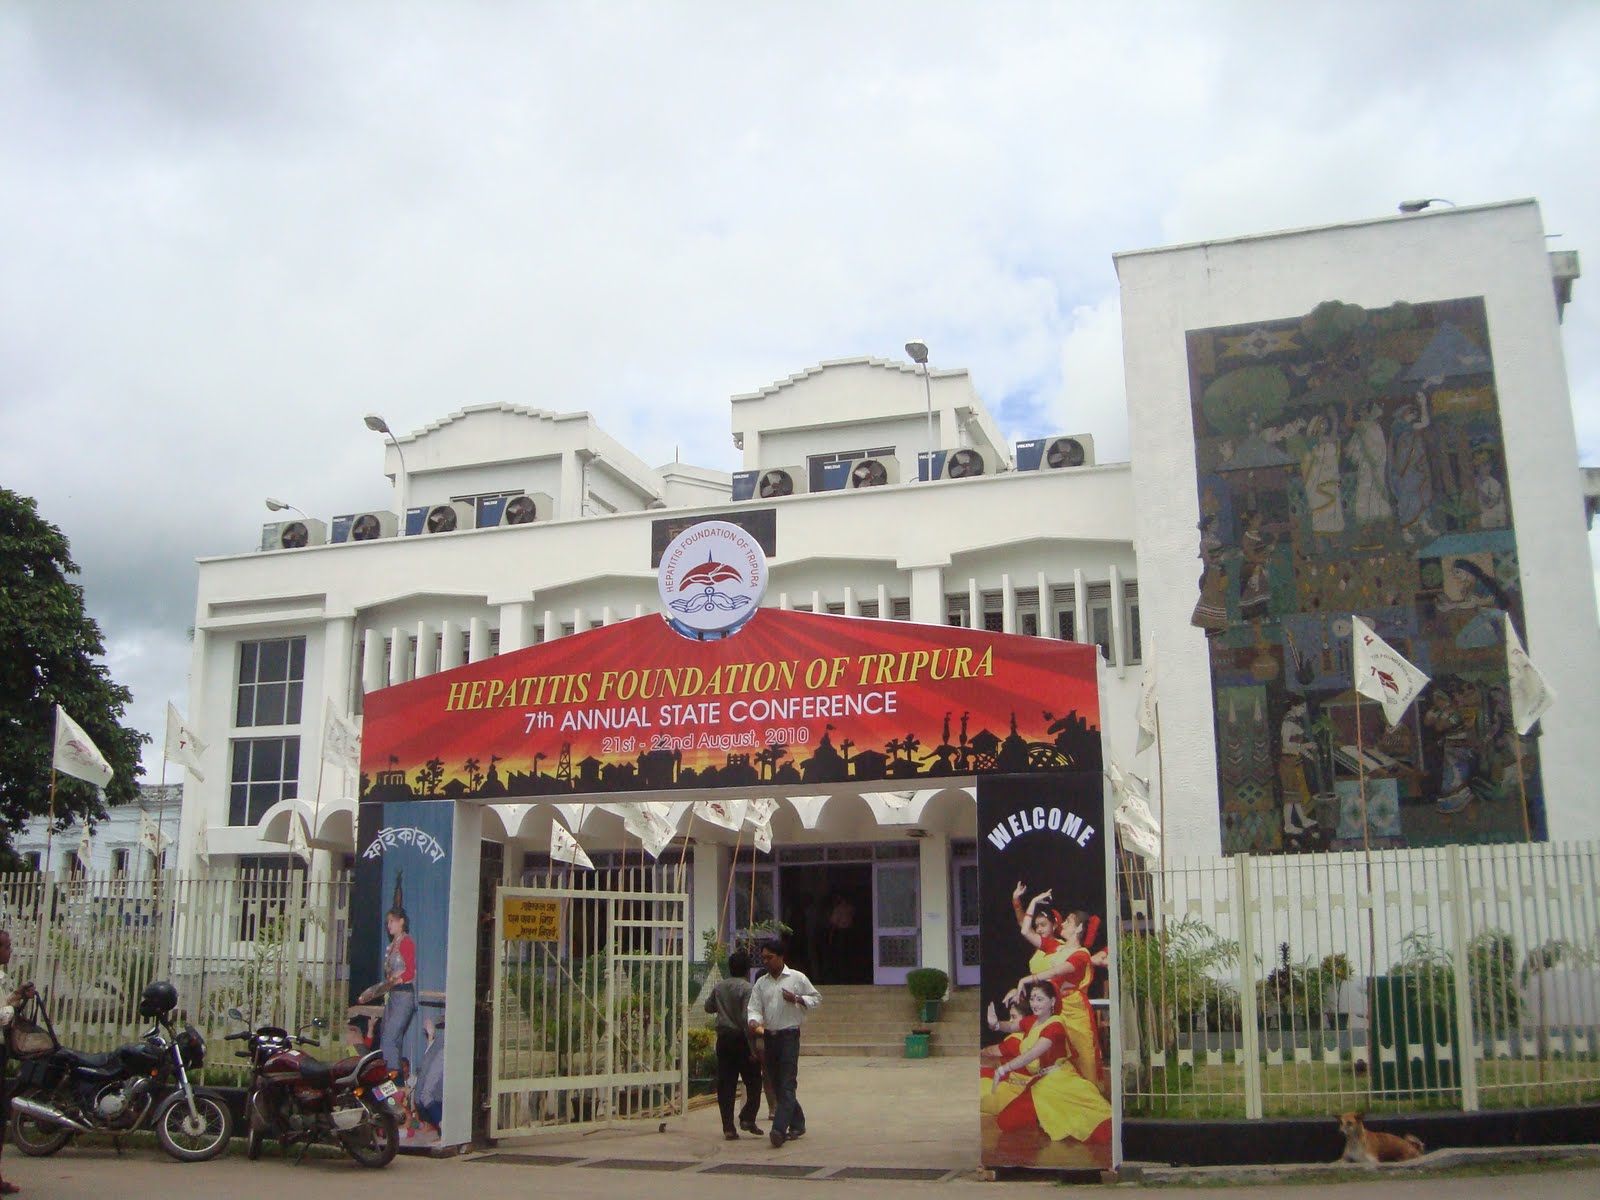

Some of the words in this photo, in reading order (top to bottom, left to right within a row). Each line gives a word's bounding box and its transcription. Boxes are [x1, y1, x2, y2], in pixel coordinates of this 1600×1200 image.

[665, 548, 683, 593] HEPATITIS
[680, 528, 737, 550] FOUNDATION
[736, 538, 749, 549] OF
[745, 549, 760, 588] TRIPURA
[445, 672, 592, 712] HEPATITIS
[597, 660, 800, 702] FOUNDATION
[804, 656, 850, 690] OF
[857, 644, 995, 687] TRIPURA
[525, 711, 554, 734] 7th
[560, 706, 652, 732] ANNUAL
[659, 703, 720, 727] STATE
[729, 691, 897, 723] CONFERENCE
[602, 735, 635, 754] 21st
[650, 732, 694, 751] 22nd
[697, 729, 759, 752] August,
[765, 726, 809, 746] 2010
[987, 806, 1095, 851] WELCOME
